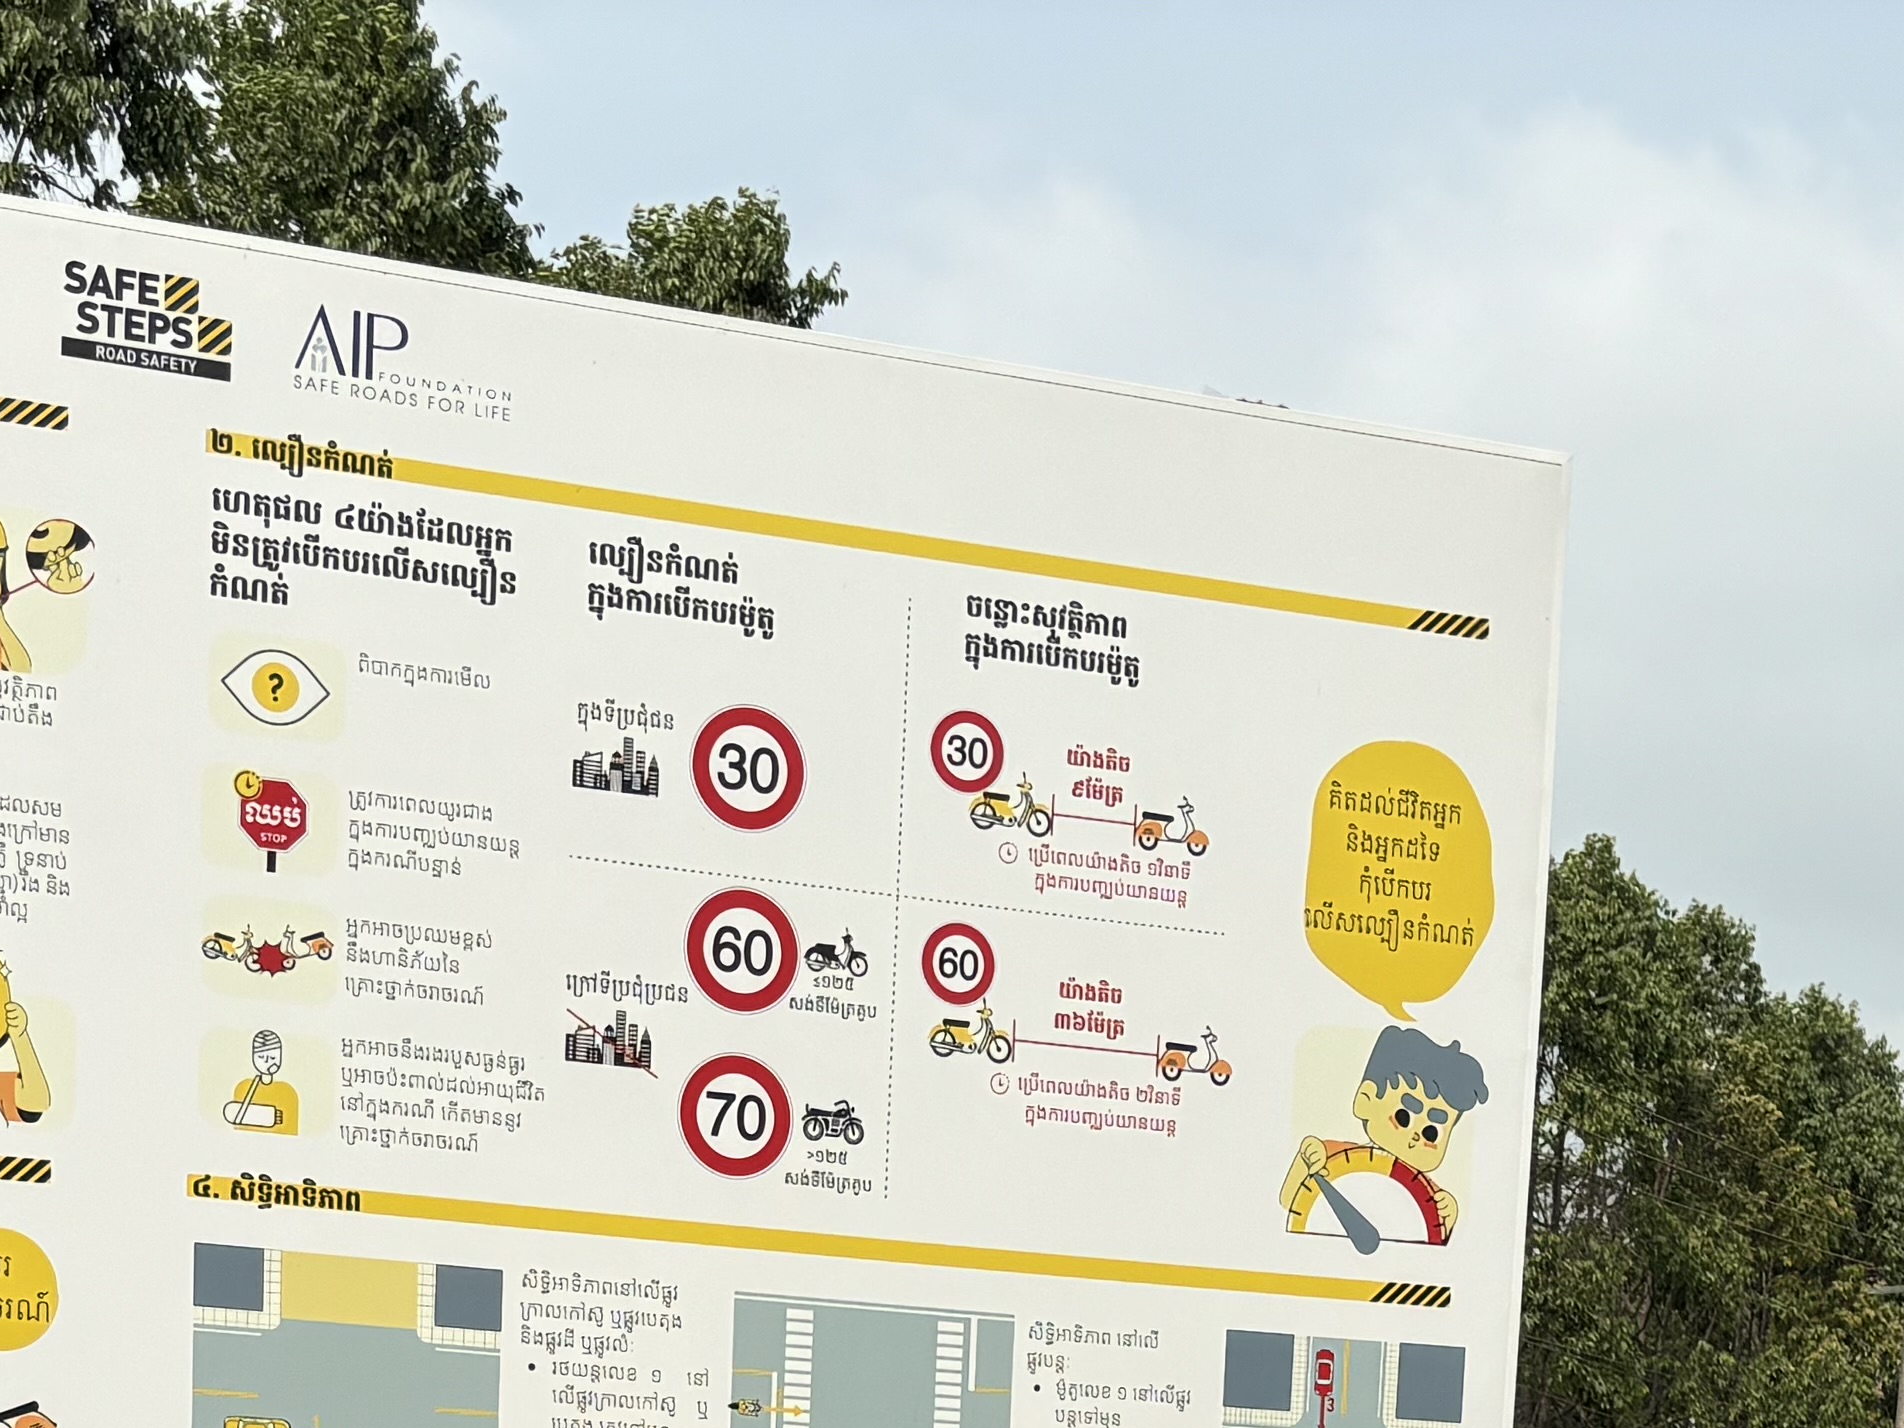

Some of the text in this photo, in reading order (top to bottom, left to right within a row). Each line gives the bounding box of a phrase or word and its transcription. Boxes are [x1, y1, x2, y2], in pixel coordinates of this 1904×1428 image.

[64, 260, 160, 306] SAFE
[76, 301, 192, 348] STEPS
[295, 304, 409, 381] AIP
[95, 345, 197, 374] ROAD SAFETY
[294, 375, 510, 422] SAFE ROADS FOR LIFE
[379, 372, 511, 405] FOUNDATION
[718, 743, 779, 793] 30
[947, 735, 988, 769] 30
[245, 797, 301, 828] ឈប់
[260, 832, 287, 843] STOP
[713, 926, 773, 975] 60
[939, 947, 979, 981] 60
[706, 1091, 766, 1141] 70
